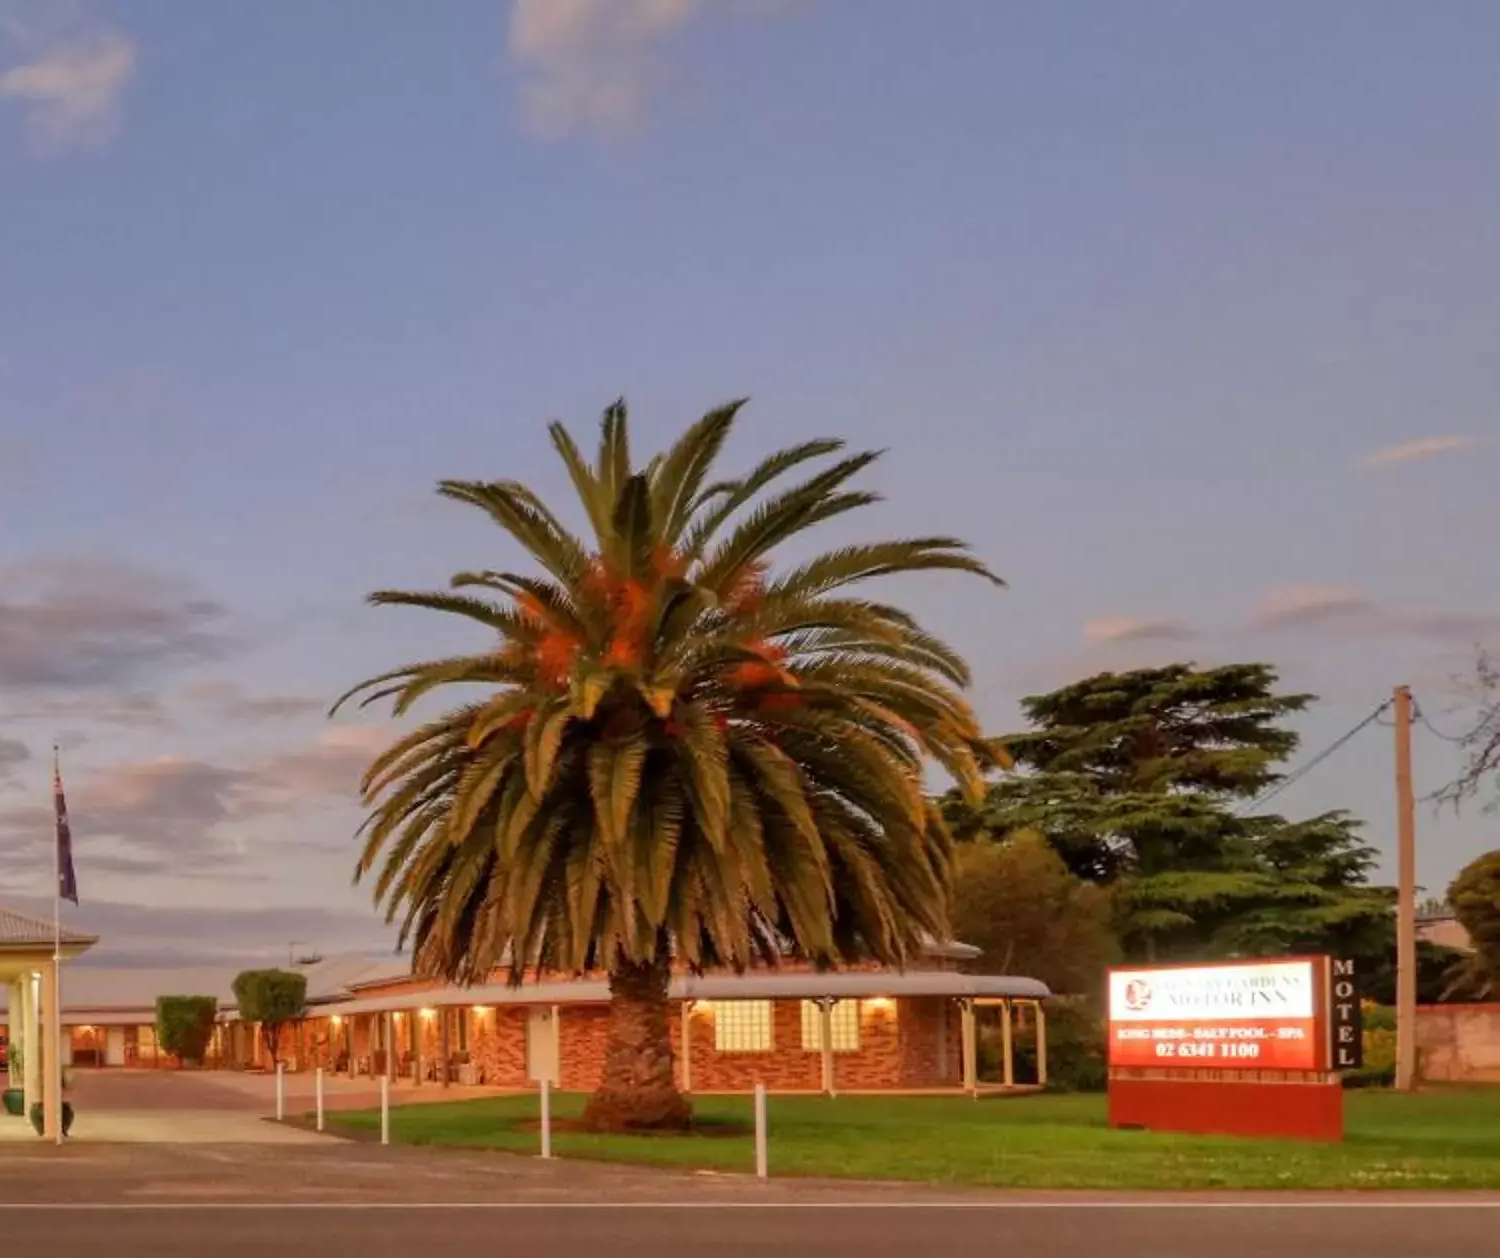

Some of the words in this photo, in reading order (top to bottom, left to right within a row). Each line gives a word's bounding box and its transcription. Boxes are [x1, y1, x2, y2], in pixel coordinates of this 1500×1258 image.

[1333, 958, 1355, 1066] MOTEL
[1155, 1043, 1175, 1057] 02
[1221, 1043, 1260, 1057] 1100
